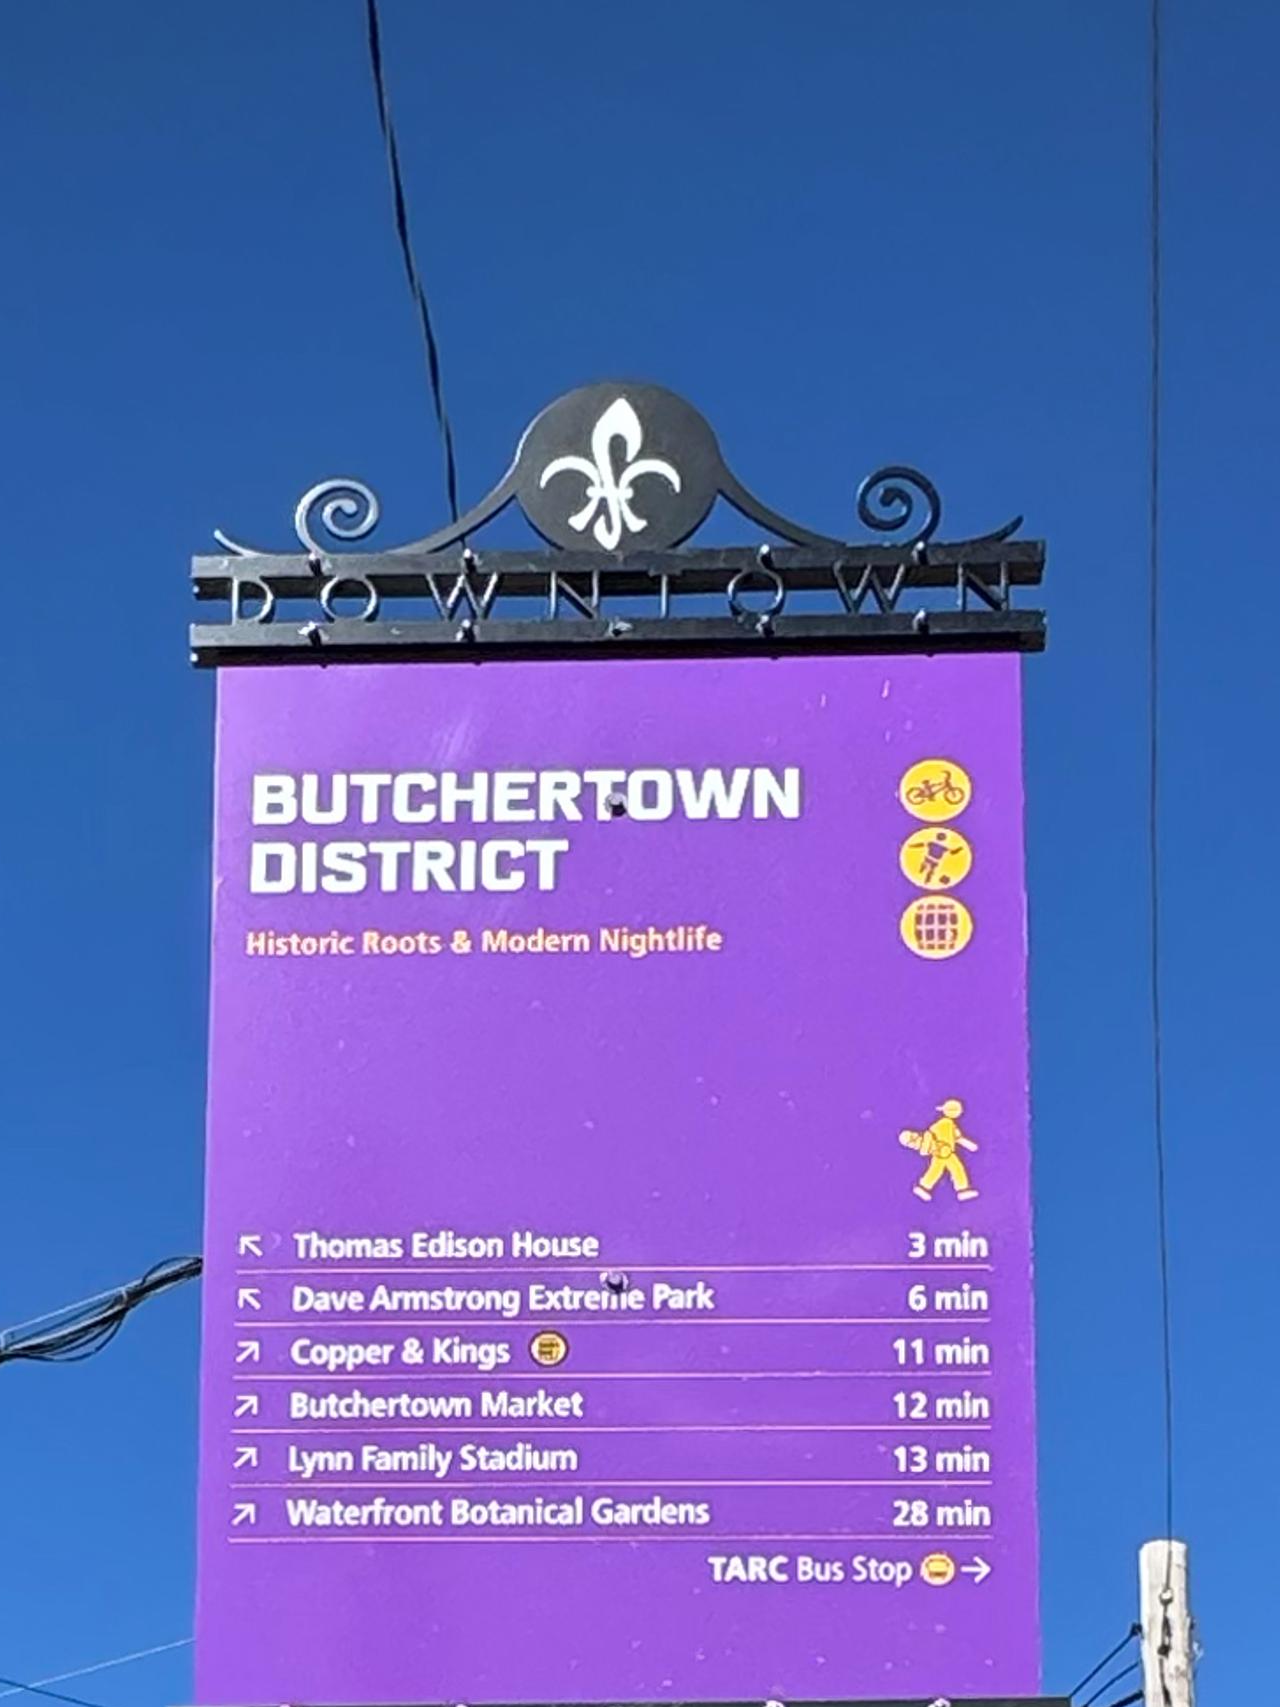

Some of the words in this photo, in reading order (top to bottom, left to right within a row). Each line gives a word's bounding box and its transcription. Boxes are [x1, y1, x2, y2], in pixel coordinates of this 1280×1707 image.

[230, 560, 1014, 625] DOWNTOWN
[252, 767, 800, 825] BUTCHERTOWN
[250, 839, 569, 894] DISTRICT
[246, 927, 355, 956] Historic
[362, 930, 442, 954] Roots
[449, 930, 472, 954] &
[481, 927, 590, 953] Modern
[600, 925, 722, 958] Nightlife
[293, 1231, 404, 1259] Thomas
[411, 1230, 504, 1258] Edison
[512, 1231, 599, 1258] House
[908, 1232, 926, 1258] 3
[934, 1230, 988, 1258] min
[292, 1286, 365, 1312] Dave
[369, 1284, 521, 1318] Armstrong
[529, 1284, 645, 1311] Extreme
[652, 1281, 715, 1310] Park
[908, 1284, 927, 1312] 6
[935, 1283, 988, 1310] min
[290, 1338, 395, 1371] Copper
[401, 1337, 424, 1364] &
[432, 1336, 511, 1371] Kings
[893, 1338, 924, 1365] 11
[935, 1337, 989, 1364] min
[290, 1389, 472, 1419] Butchertown
[481, 1389, 584, 1418] Market
[893, 1391, 928, 1419] 12
[935, 1390, 990, 1418] min
[289, 1445, 354, 1478] Lynn
[361, 1443, 453, 1478] Family
[459, 1442, 578, 1471] Stadium
[894, 1445, 928, 1473] 13
[935, 1445, 990, 1472] min
[286, 1497, 443, 1526] Waterfront
[451, 1496, 583, 1525] Botanical
[591, 1495, 710, 1525] Gardens
[893, 1499, 929, 1527] 28
[936, 1499, 991, 1526] min
[707, 1555, 788, 1582] TARC
[797, 1556, 845, 1582] Bus
[852, 1555, 913, 1587] Stop
